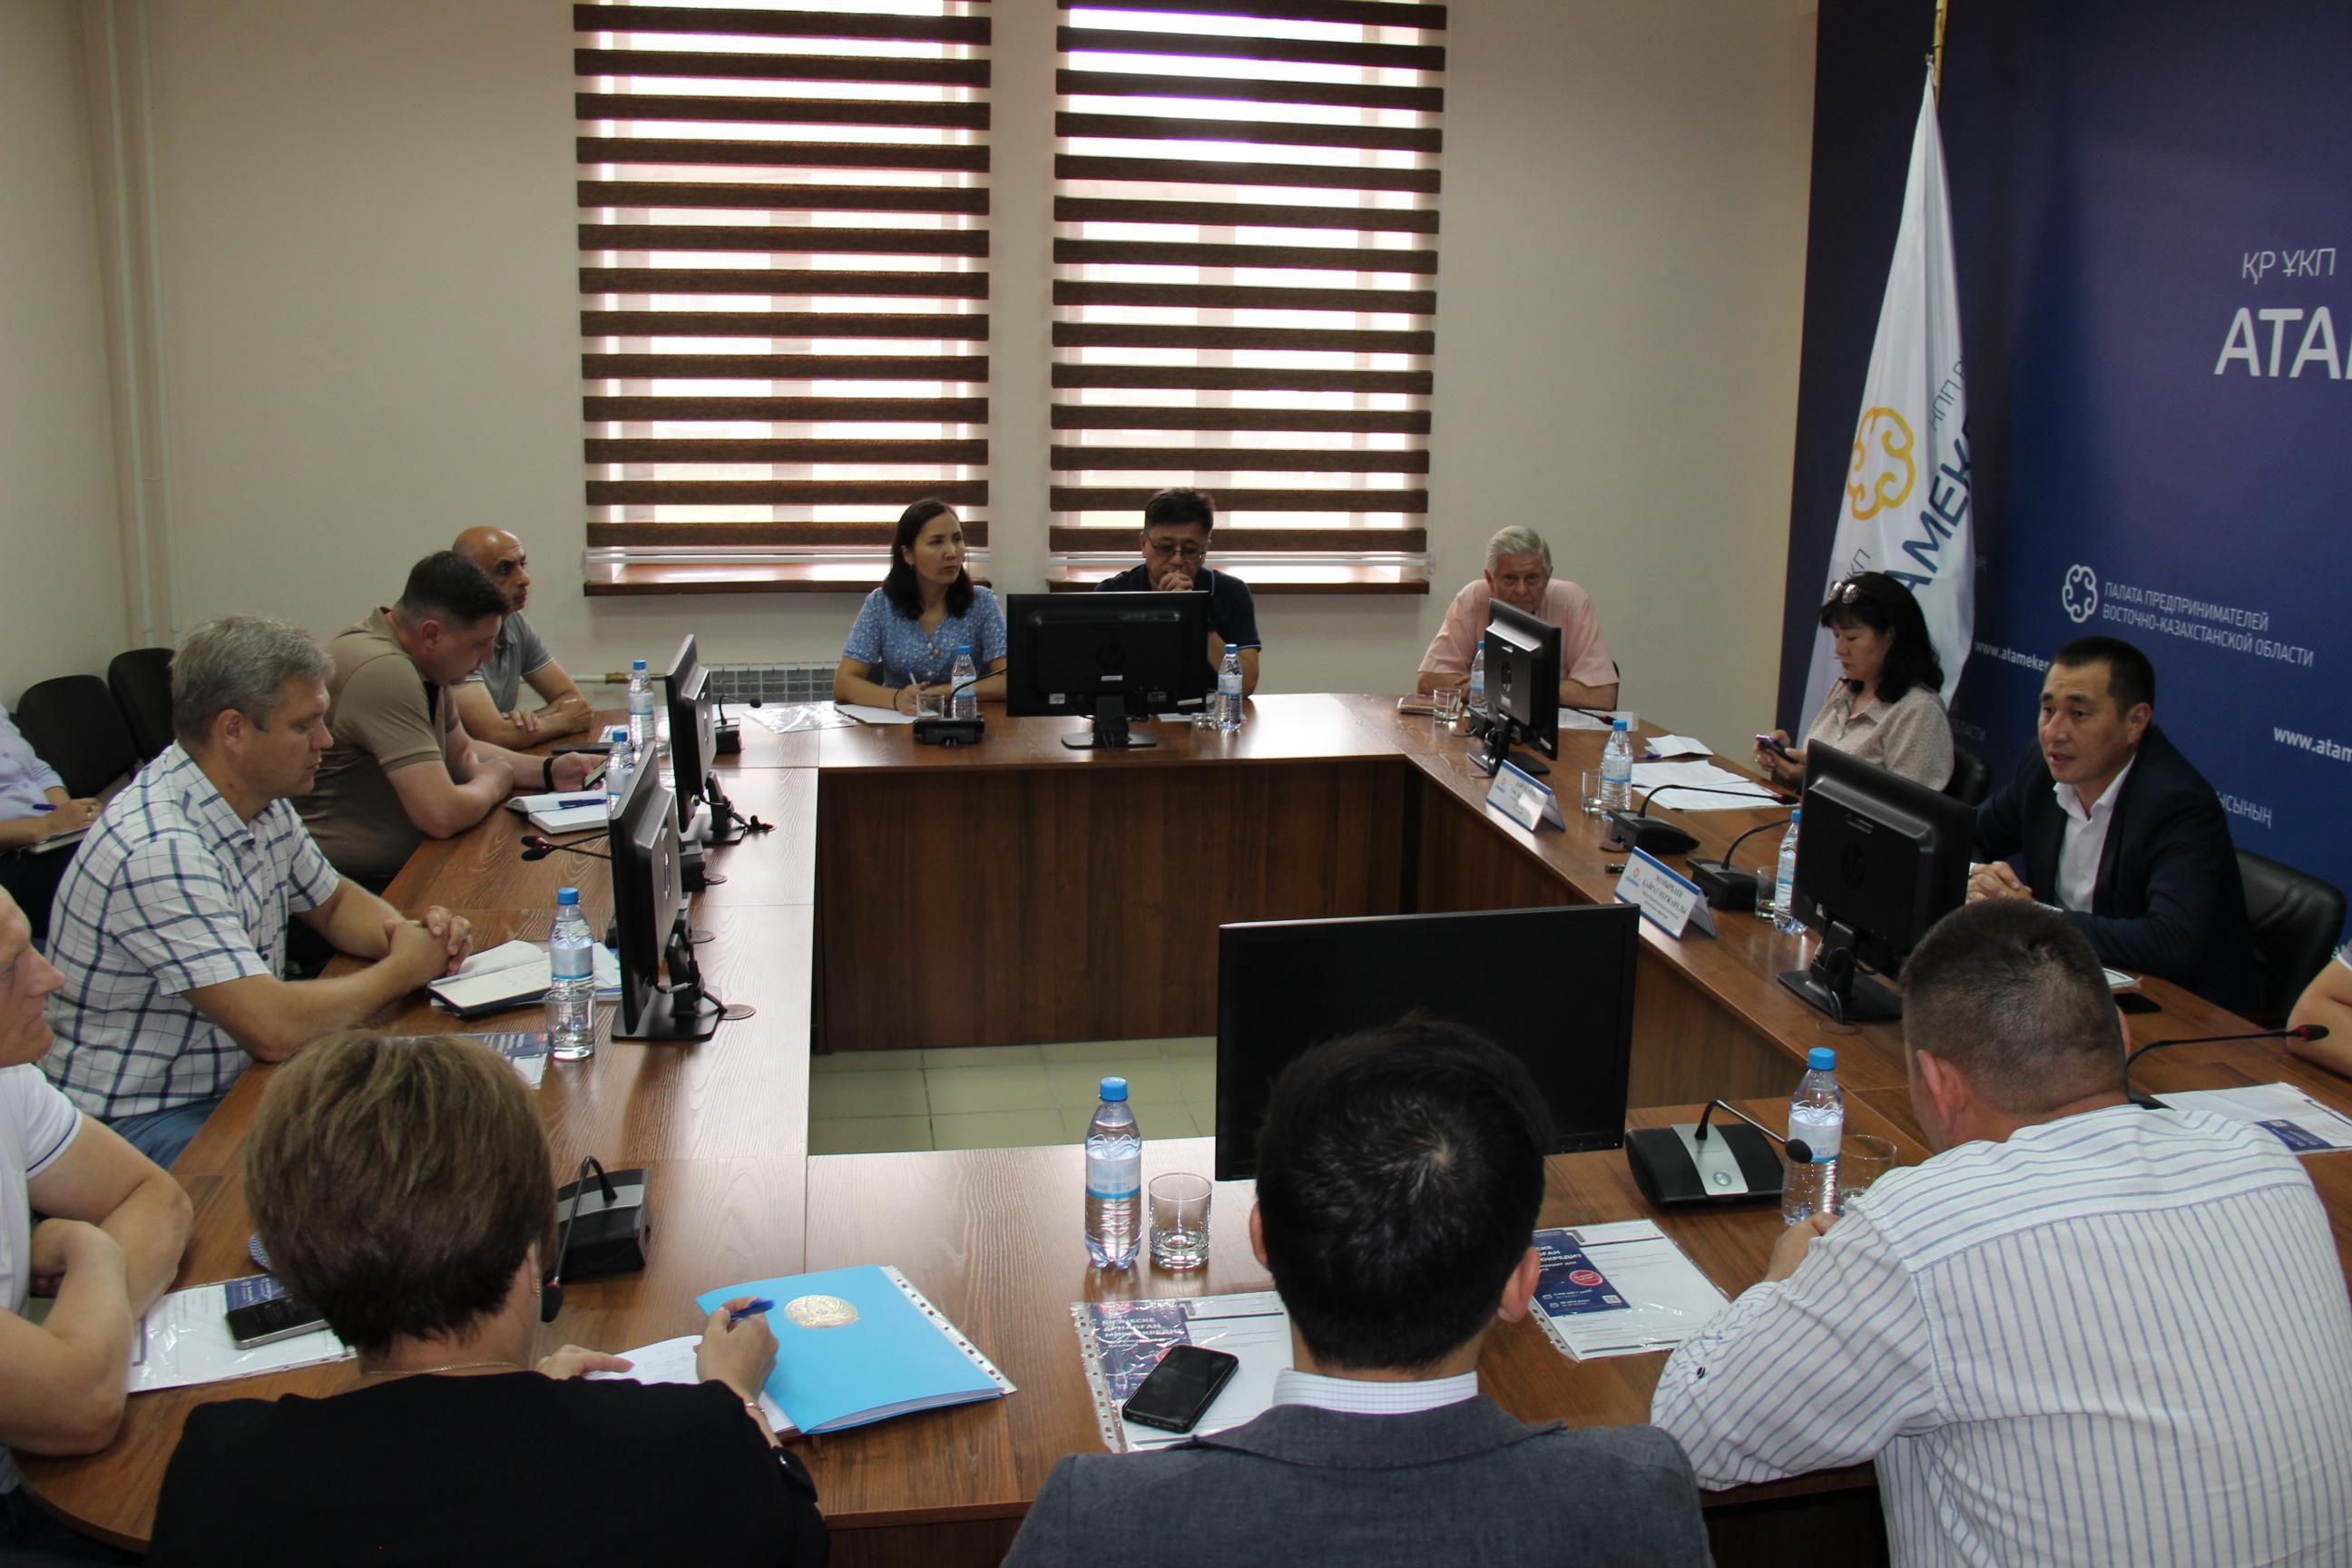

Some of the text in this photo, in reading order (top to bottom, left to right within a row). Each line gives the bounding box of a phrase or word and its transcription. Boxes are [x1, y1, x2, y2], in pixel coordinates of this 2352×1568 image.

[2213, 305, 2352, 379] АТА
[2102, 603, 2314, 667] ВОСТОЧНО-КАЗАХСТАНСКОЙ ОБЛАСТИ
[2104, 581, 2269, 632] ПАЛАТА ПРЕДПРИНИМАТЕЛЕЙ
